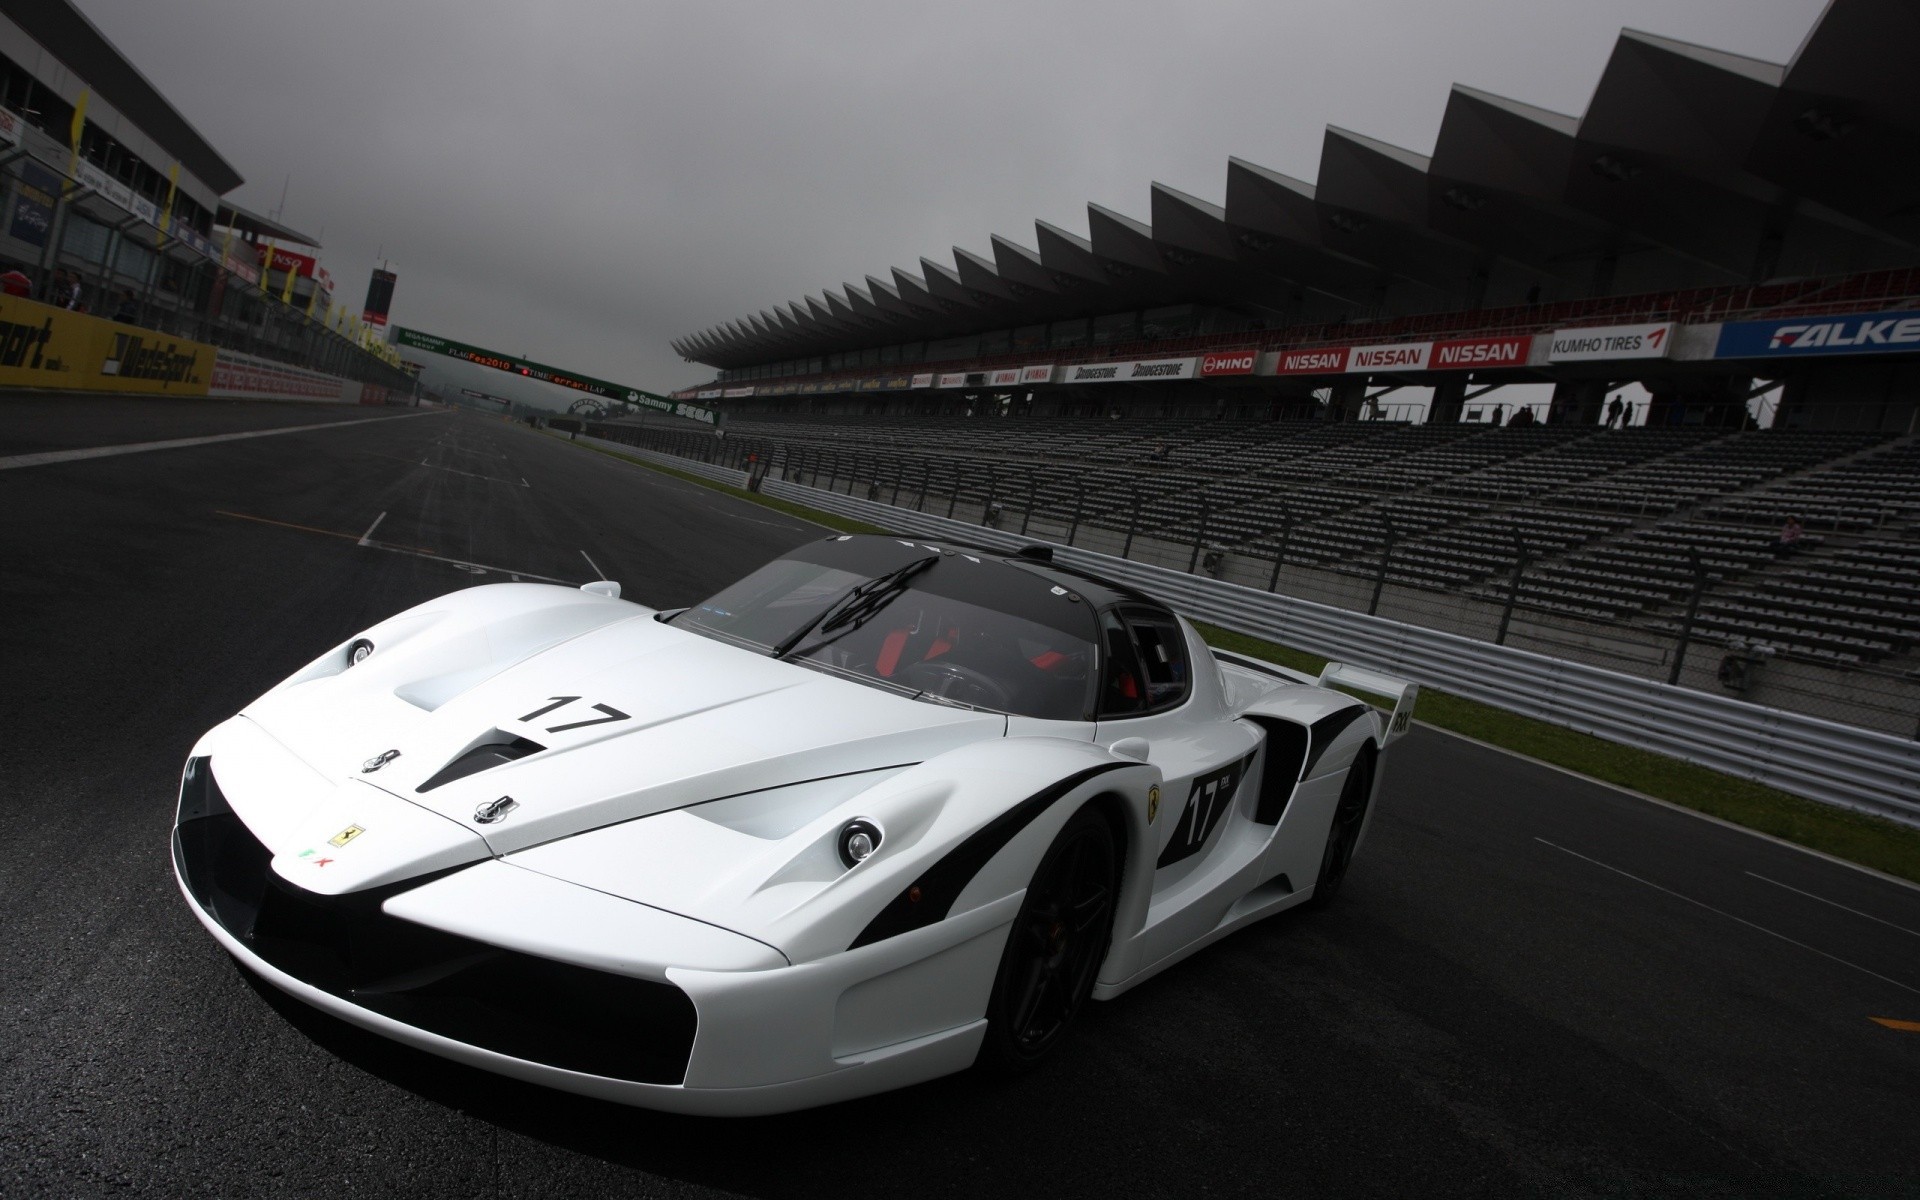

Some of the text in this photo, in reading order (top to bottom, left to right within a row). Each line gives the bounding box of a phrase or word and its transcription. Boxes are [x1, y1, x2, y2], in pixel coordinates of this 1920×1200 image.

[258, 249, 302, 268] DNSO
[1439, 342, 1519, 363] NISSAN
[1553, 335, 1641, 355] KUMHO TIRES
[1216, 357, 1253, 369] HINO
[1284, 353, 1341, 369] NISSAN
[1355, 349, 1422, 367] NISSAN
[1074, 366, 1118, 380] BRIDGESTONE
[1131, 363, 1183, 377] BRIDGESTONE
[528, 368, 549, 380] TIME
[589, 384, 606, 396] LAP
[638, 394, 673, 413] Sammy
[676, 403, 715, 424] SEGA
[517, 696, 632, 734] 17
[1187, 779, 1218, 846] 17
